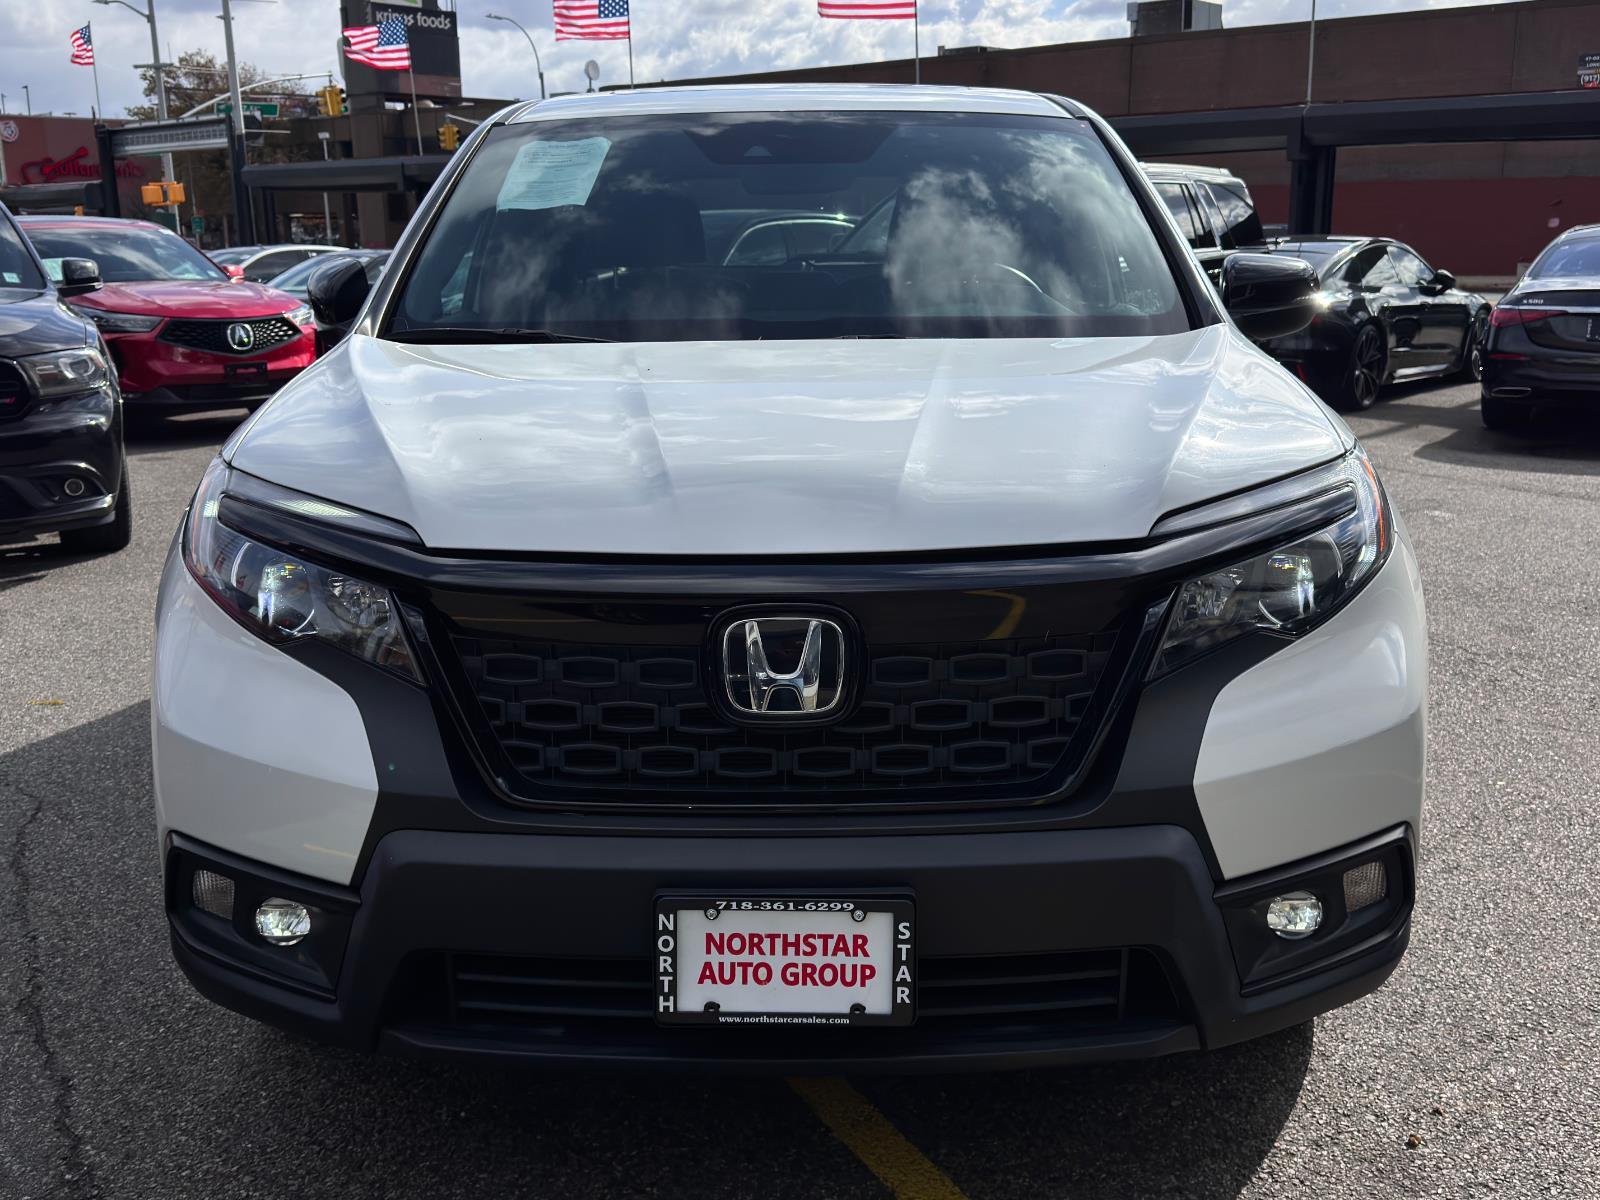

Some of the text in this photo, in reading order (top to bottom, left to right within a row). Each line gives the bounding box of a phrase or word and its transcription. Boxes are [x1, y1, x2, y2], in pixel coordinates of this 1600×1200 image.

[416, 12, 451, 29] foods
[715, 901, 855, 912] 718-361-6299
[705, 932, 870, 958] NORTHSTAR
[657, 913, 675, 1013] NORTH
[697, 961, 877, 988] AUTO GROUP
[895, 921, 912, 1004] STAR
[718, 1014, 850, 1025] www.northstarcarsales.com
